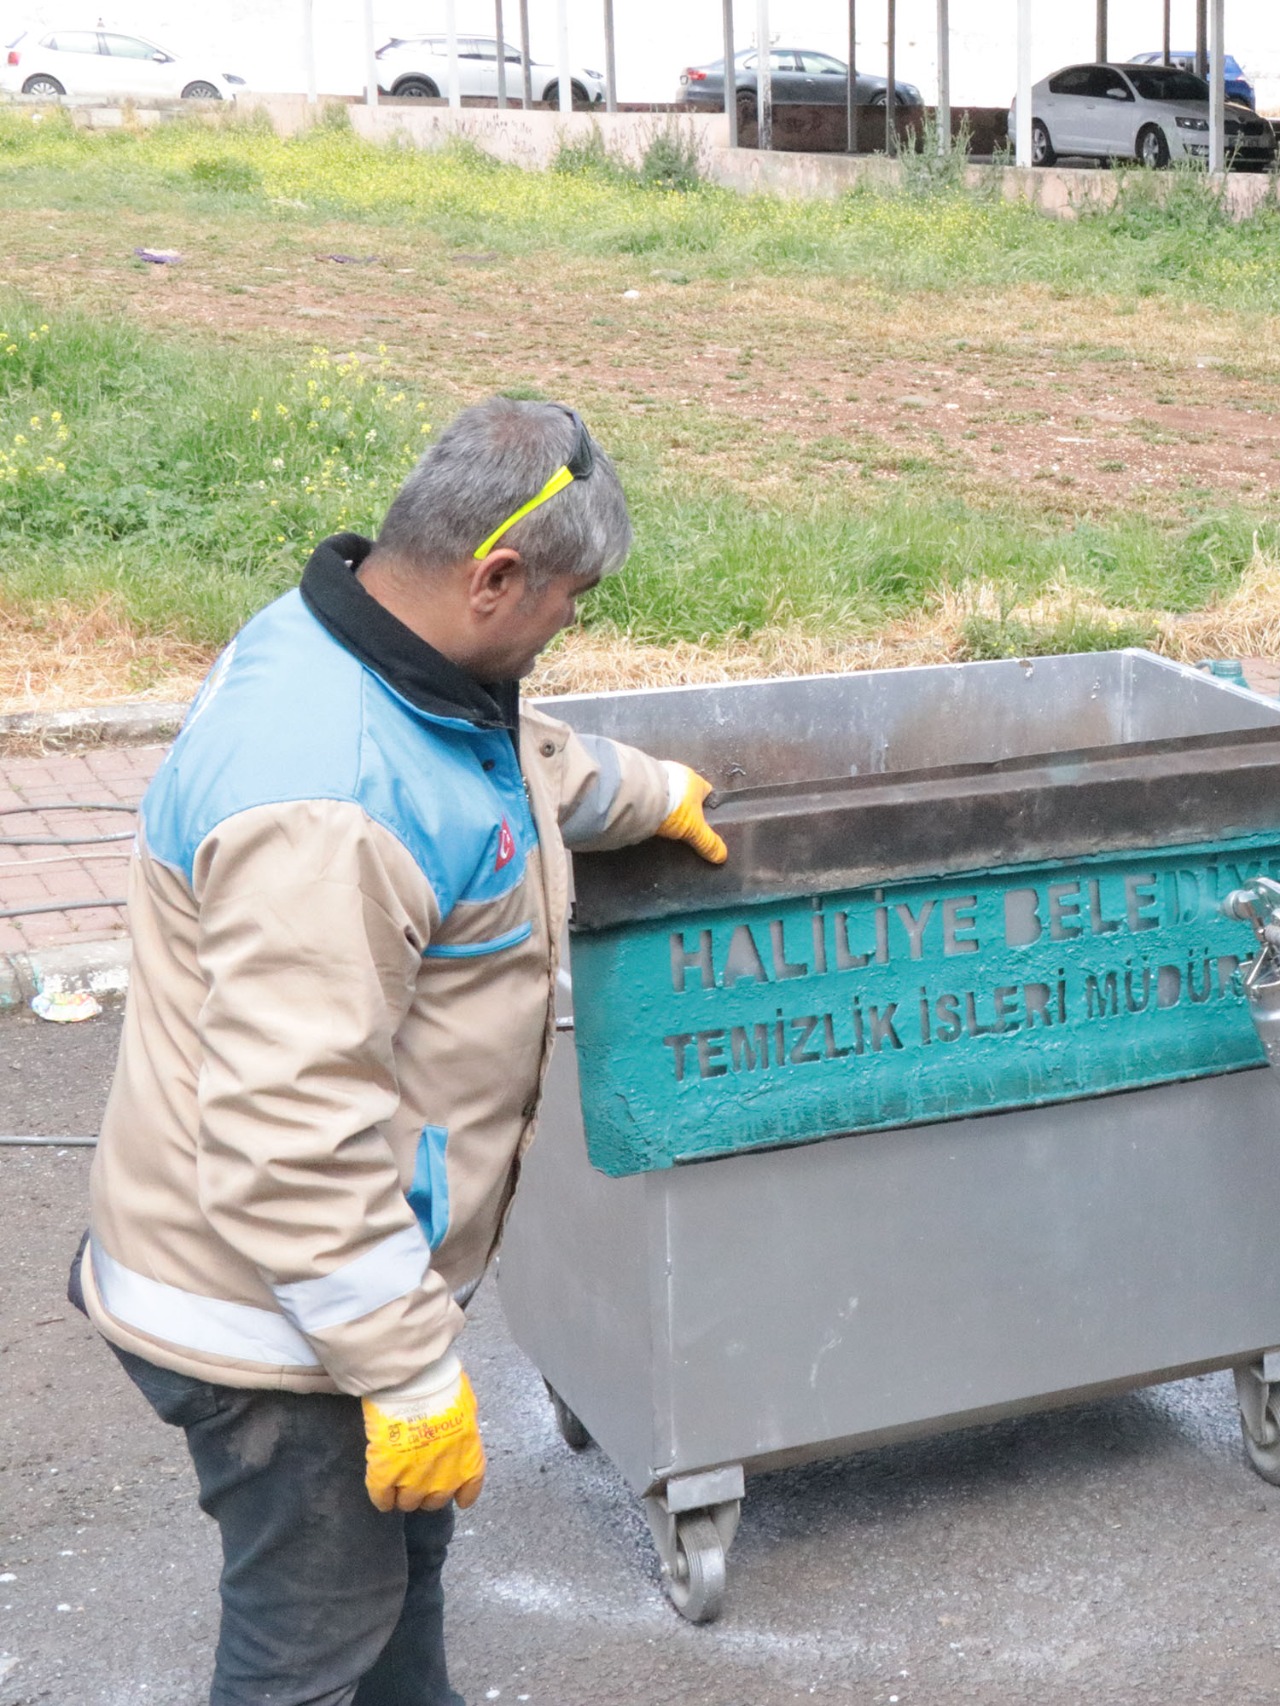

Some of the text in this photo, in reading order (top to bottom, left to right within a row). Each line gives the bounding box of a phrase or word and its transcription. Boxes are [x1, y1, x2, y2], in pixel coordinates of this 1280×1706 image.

[669, 887, 980, 993] HALİLİYE
[663, 995, 904, 1082] TEMİZLİK
[1085, 946, 1254, 1019] MÜDÜR
